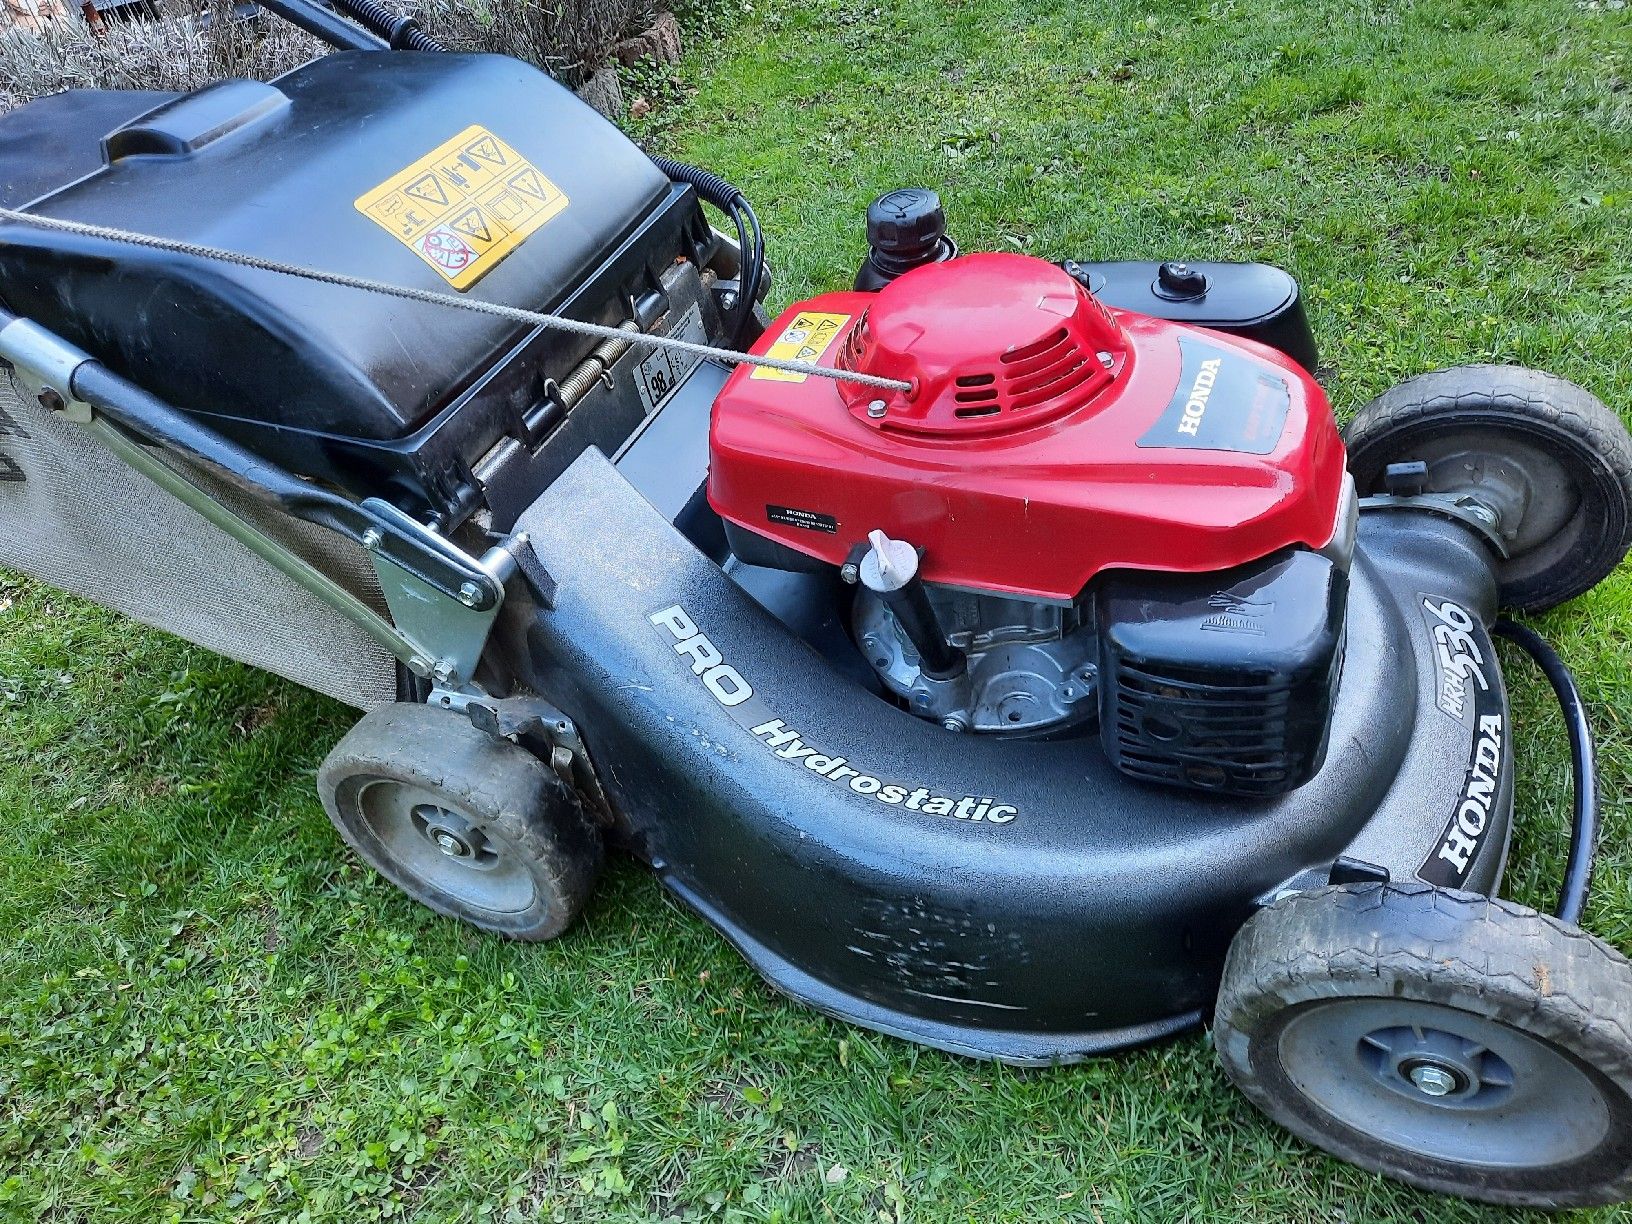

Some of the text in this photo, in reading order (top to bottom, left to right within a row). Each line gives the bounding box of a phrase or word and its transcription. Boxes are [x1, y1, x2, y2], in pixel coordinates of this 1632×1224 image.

[651, 370, 668, 399] 98
[1177, 358, 1222, 437] HONDA
[785, 509, 817, 520] HONDA
[648, 604, 1019, 824] PRO Hydrostatic
[1438, 713, 1503, 875] HONDA
